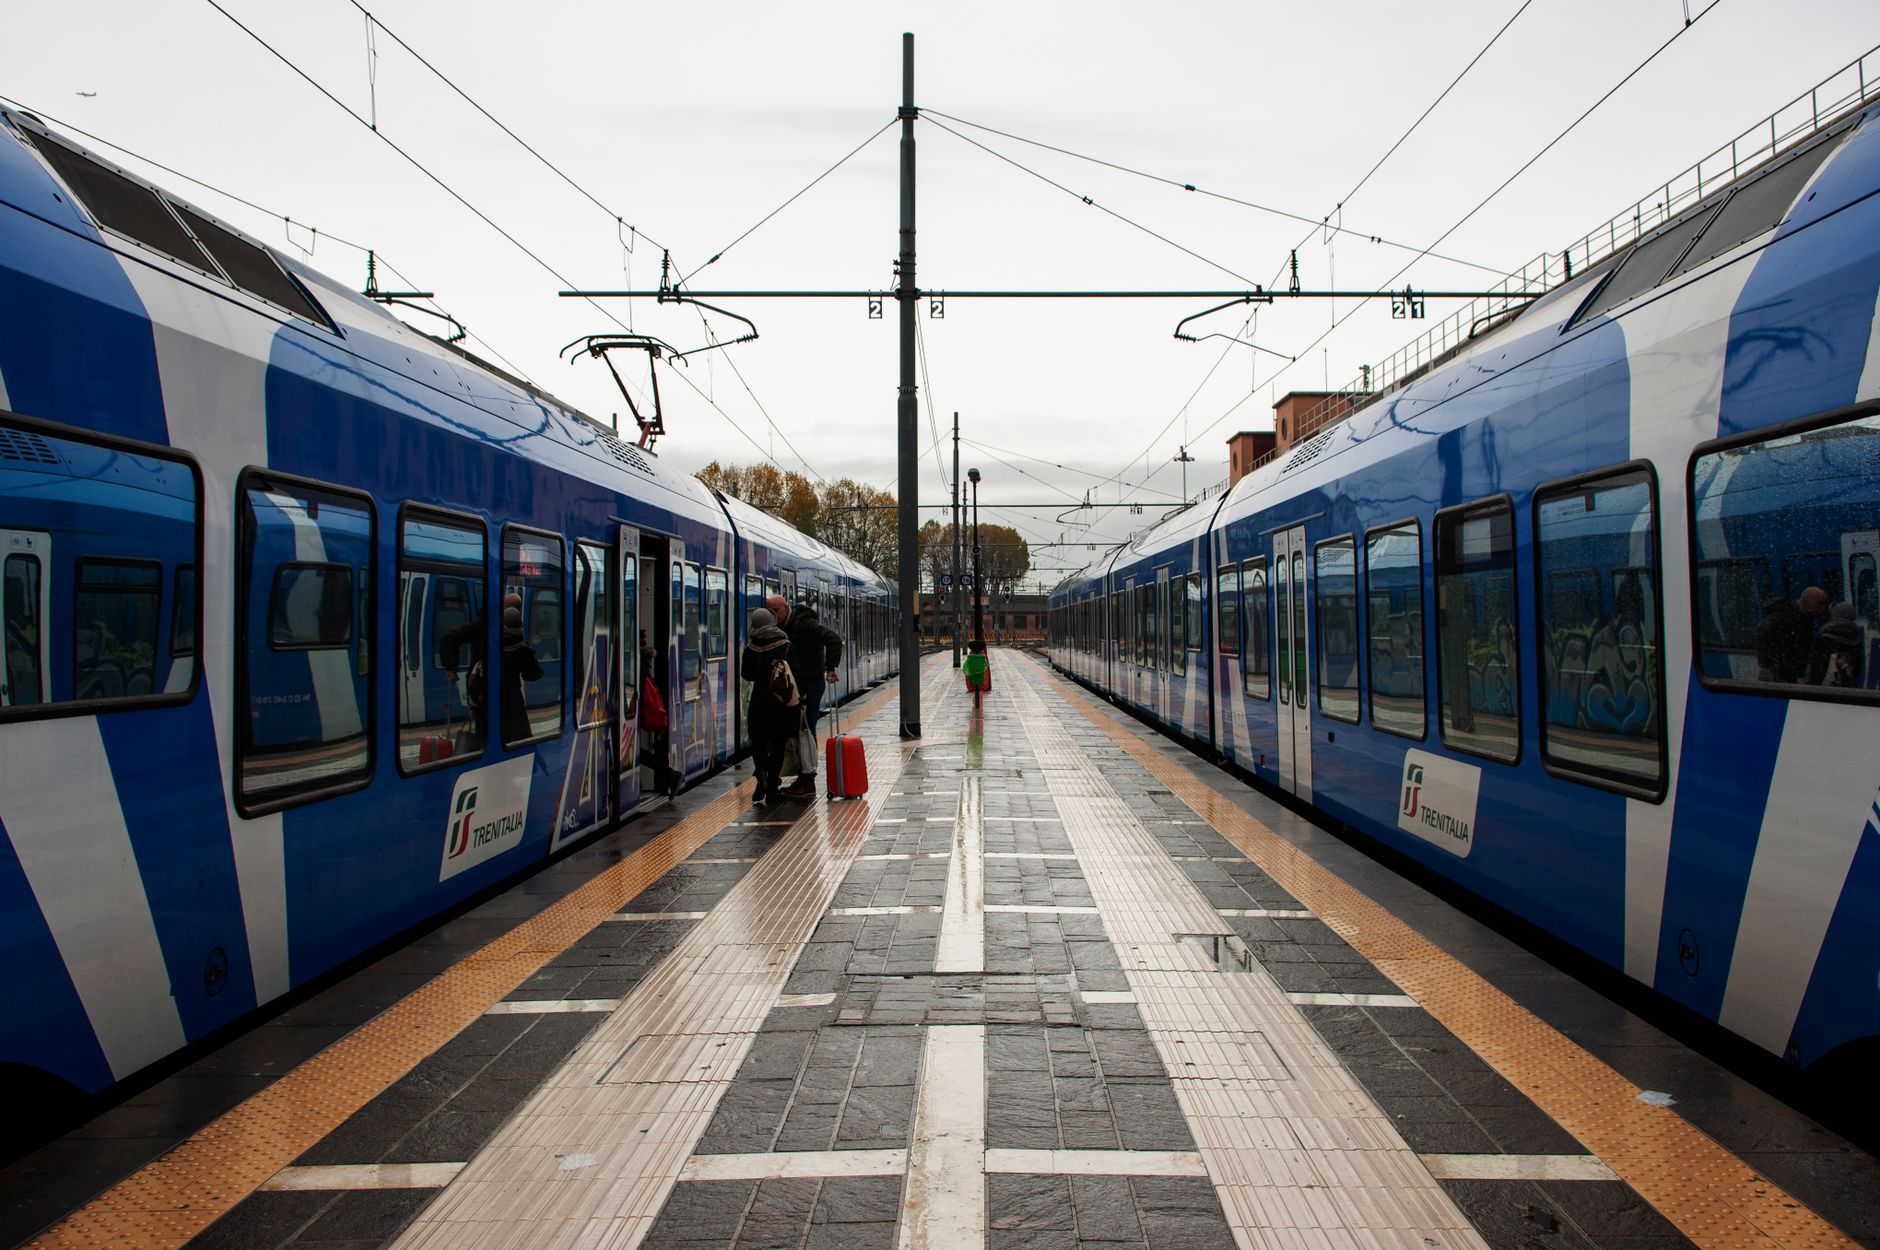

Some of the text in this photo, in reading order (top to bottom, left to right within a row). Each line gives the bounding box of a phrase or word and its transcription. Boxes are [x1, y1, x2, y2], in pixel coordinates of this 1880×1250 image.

[870, 301, 882, 318] 2
[931, 301, 943, 318] 2
[1393, 302, 1405, 318] 2
[1412, 302, 1423, 318] 1
[473, 811, 523, 849] TRENITALIA
[1421, 805, 1469, 843] TRENITALIA
